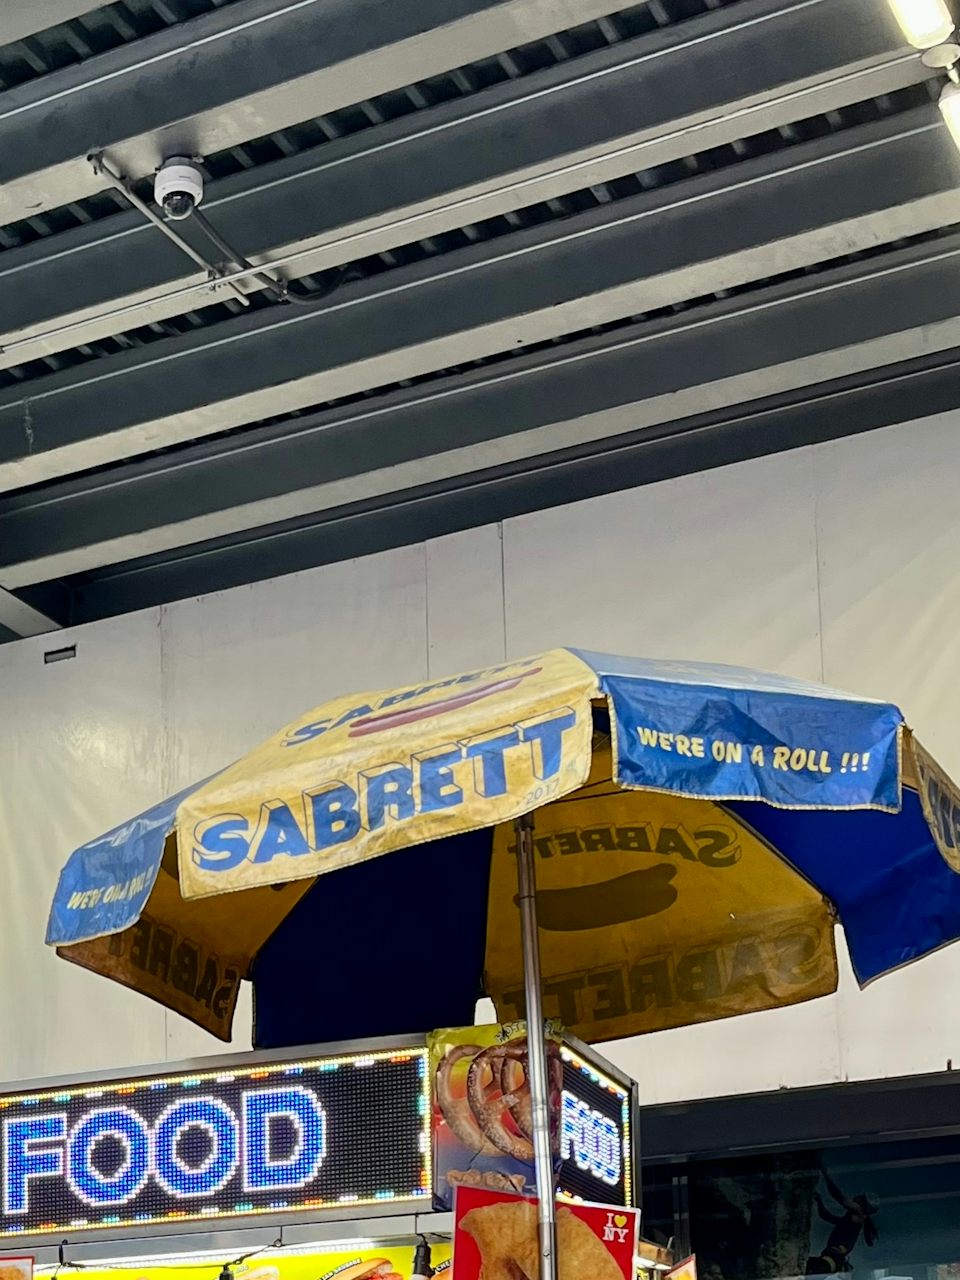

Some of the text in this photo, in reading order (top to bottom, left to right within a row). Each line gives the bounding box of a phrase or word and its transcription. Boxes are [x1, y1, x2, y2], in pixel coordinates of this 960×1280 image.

[637, 726, 705, 759] WE'RE
[712, 740, 742, 764] ON
[752, 746, 765, 766] A
[773, 745, 831, 774] ROLL
[192, 705, 577, 873] SABRETT
[525, 777, 561, 804] 2017
[3, 1085, 327, 1216] FOOD
[606, 1213, 615, 1227] I
[602, 1226, 629, 1243] NY
[333, 1258, 362, 1275] SAUSAGE
